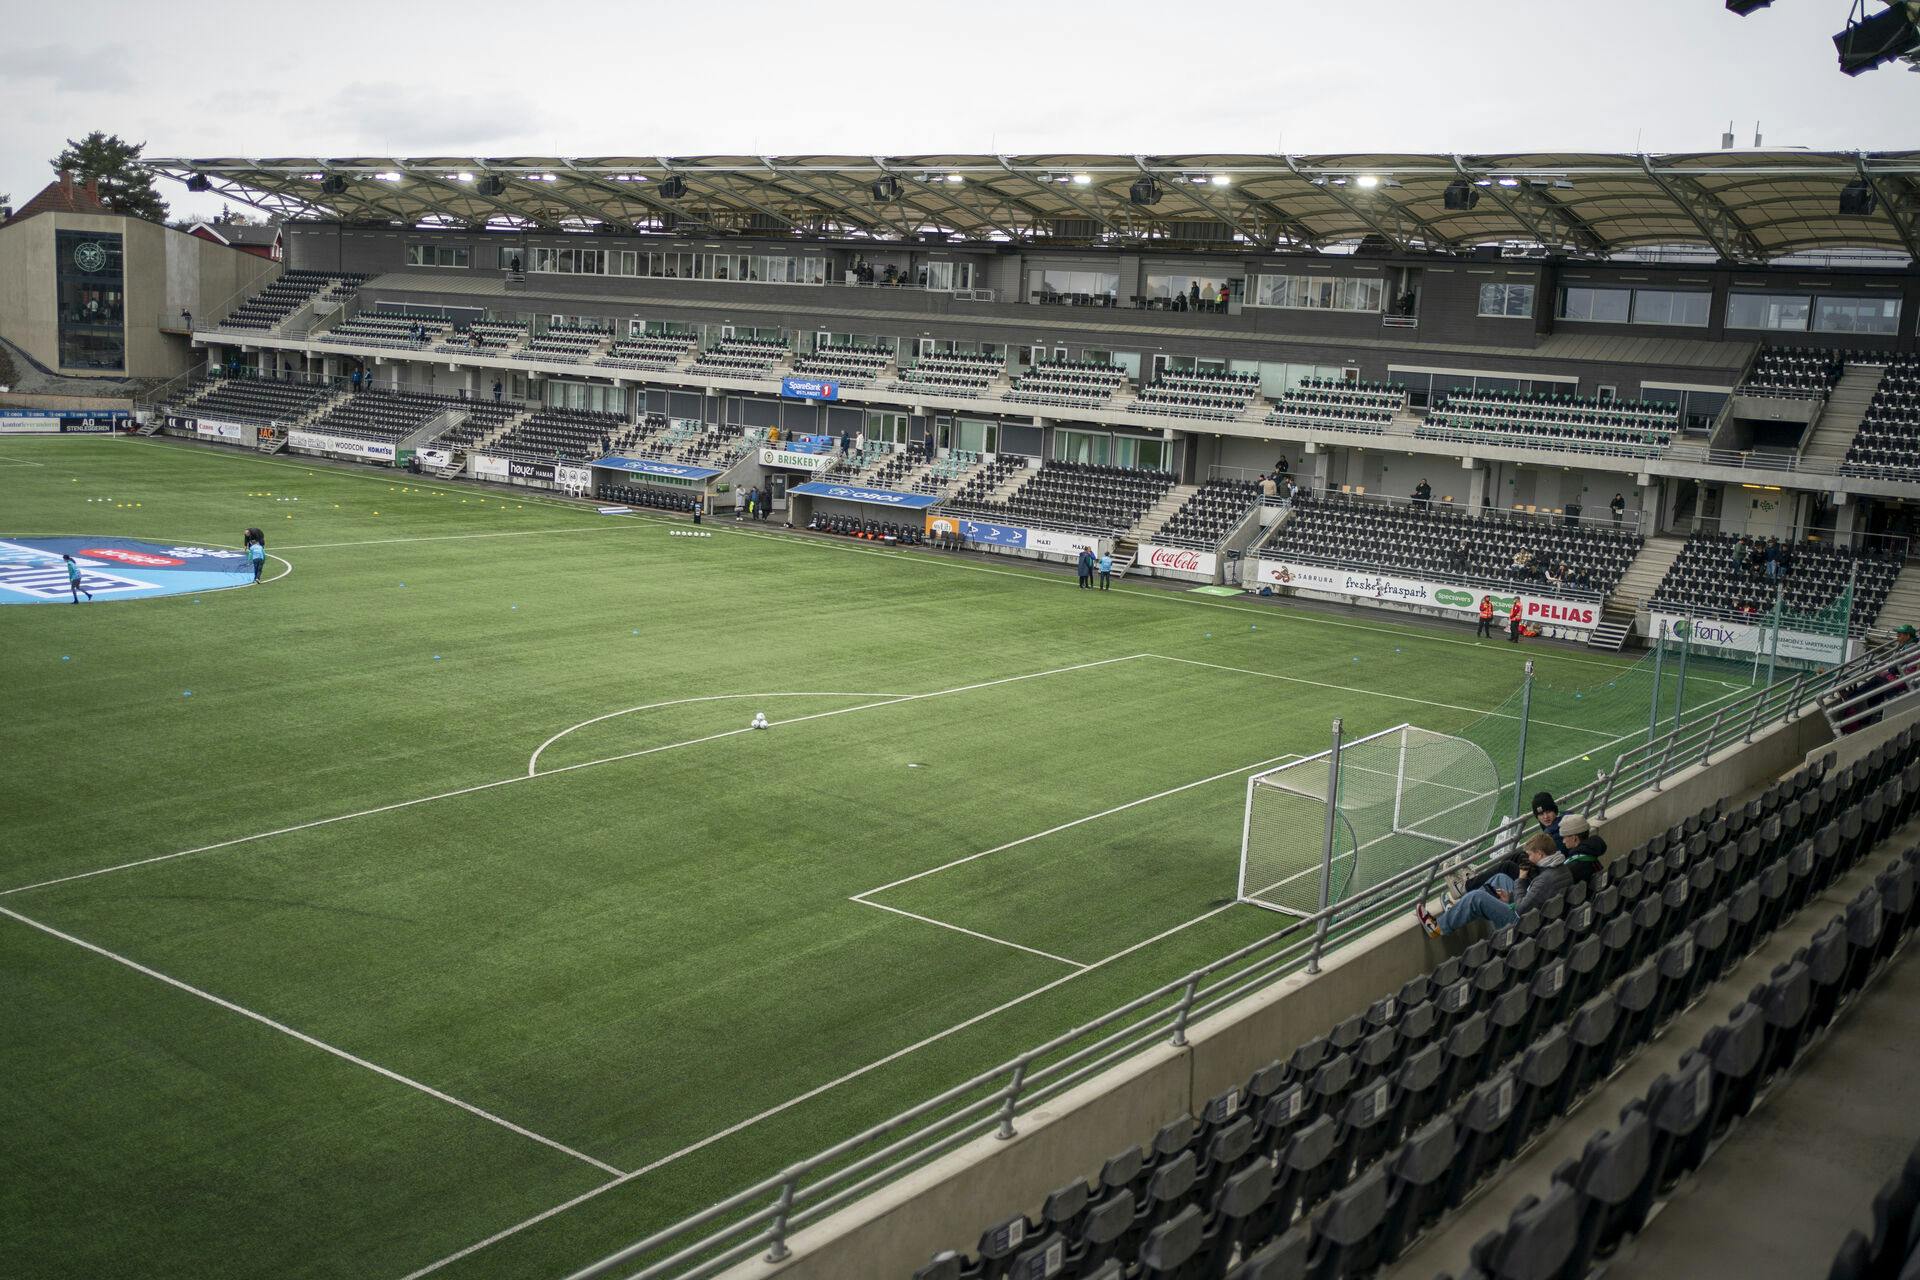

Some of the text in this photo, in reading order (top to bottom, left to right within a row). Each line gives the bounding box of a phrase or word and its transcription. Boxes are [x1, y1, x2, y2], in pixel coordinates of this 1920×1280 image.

[789, 381, 821, 391] SpareBank
[258, 427, 273, 438] JAC
[335, 441, 364, 452] WOODCON
[367, 446, 393, 455] KOMATSU
[778, 454, 820, 467] BRISKEBY
[535, 470, 554, 479] HAMAR
[852, 492, 904, 502] OBOS
[1297, 573, 1334, 583] SABRURA
[1345, 576, 1427, 599] freske fraspark
[1437, 592, 1472, 603] Specsavers
[1528, 602, 1594, 624] PELIAS
[1694, 621, 1735, 645] fønix
